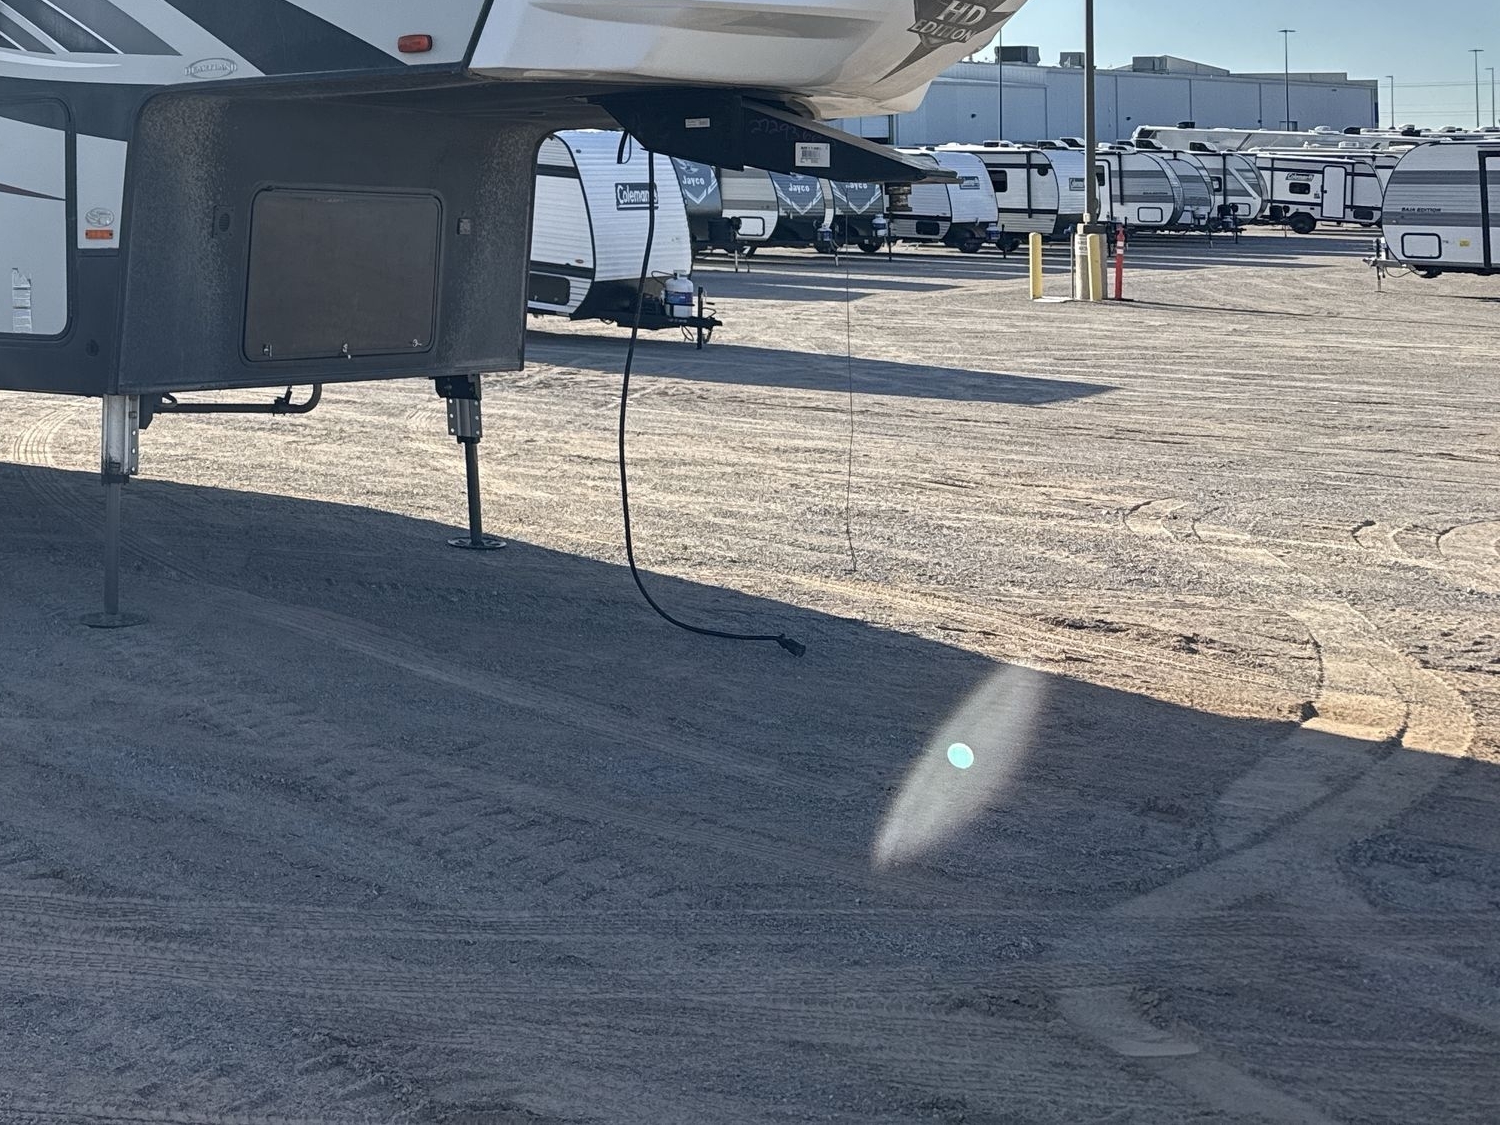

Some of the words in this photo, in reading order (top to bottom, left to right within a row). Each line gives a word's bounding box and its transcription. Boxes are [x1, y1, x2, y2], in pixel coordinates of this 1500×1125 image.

[935, 0, 987, 26] HD
[910, 18, 977, 42] EDITION
[682, 174, 705, 187] Jayco
[788, 182, 810, 194] Jayco
[1416, 206, 1442, 214] EDITION
